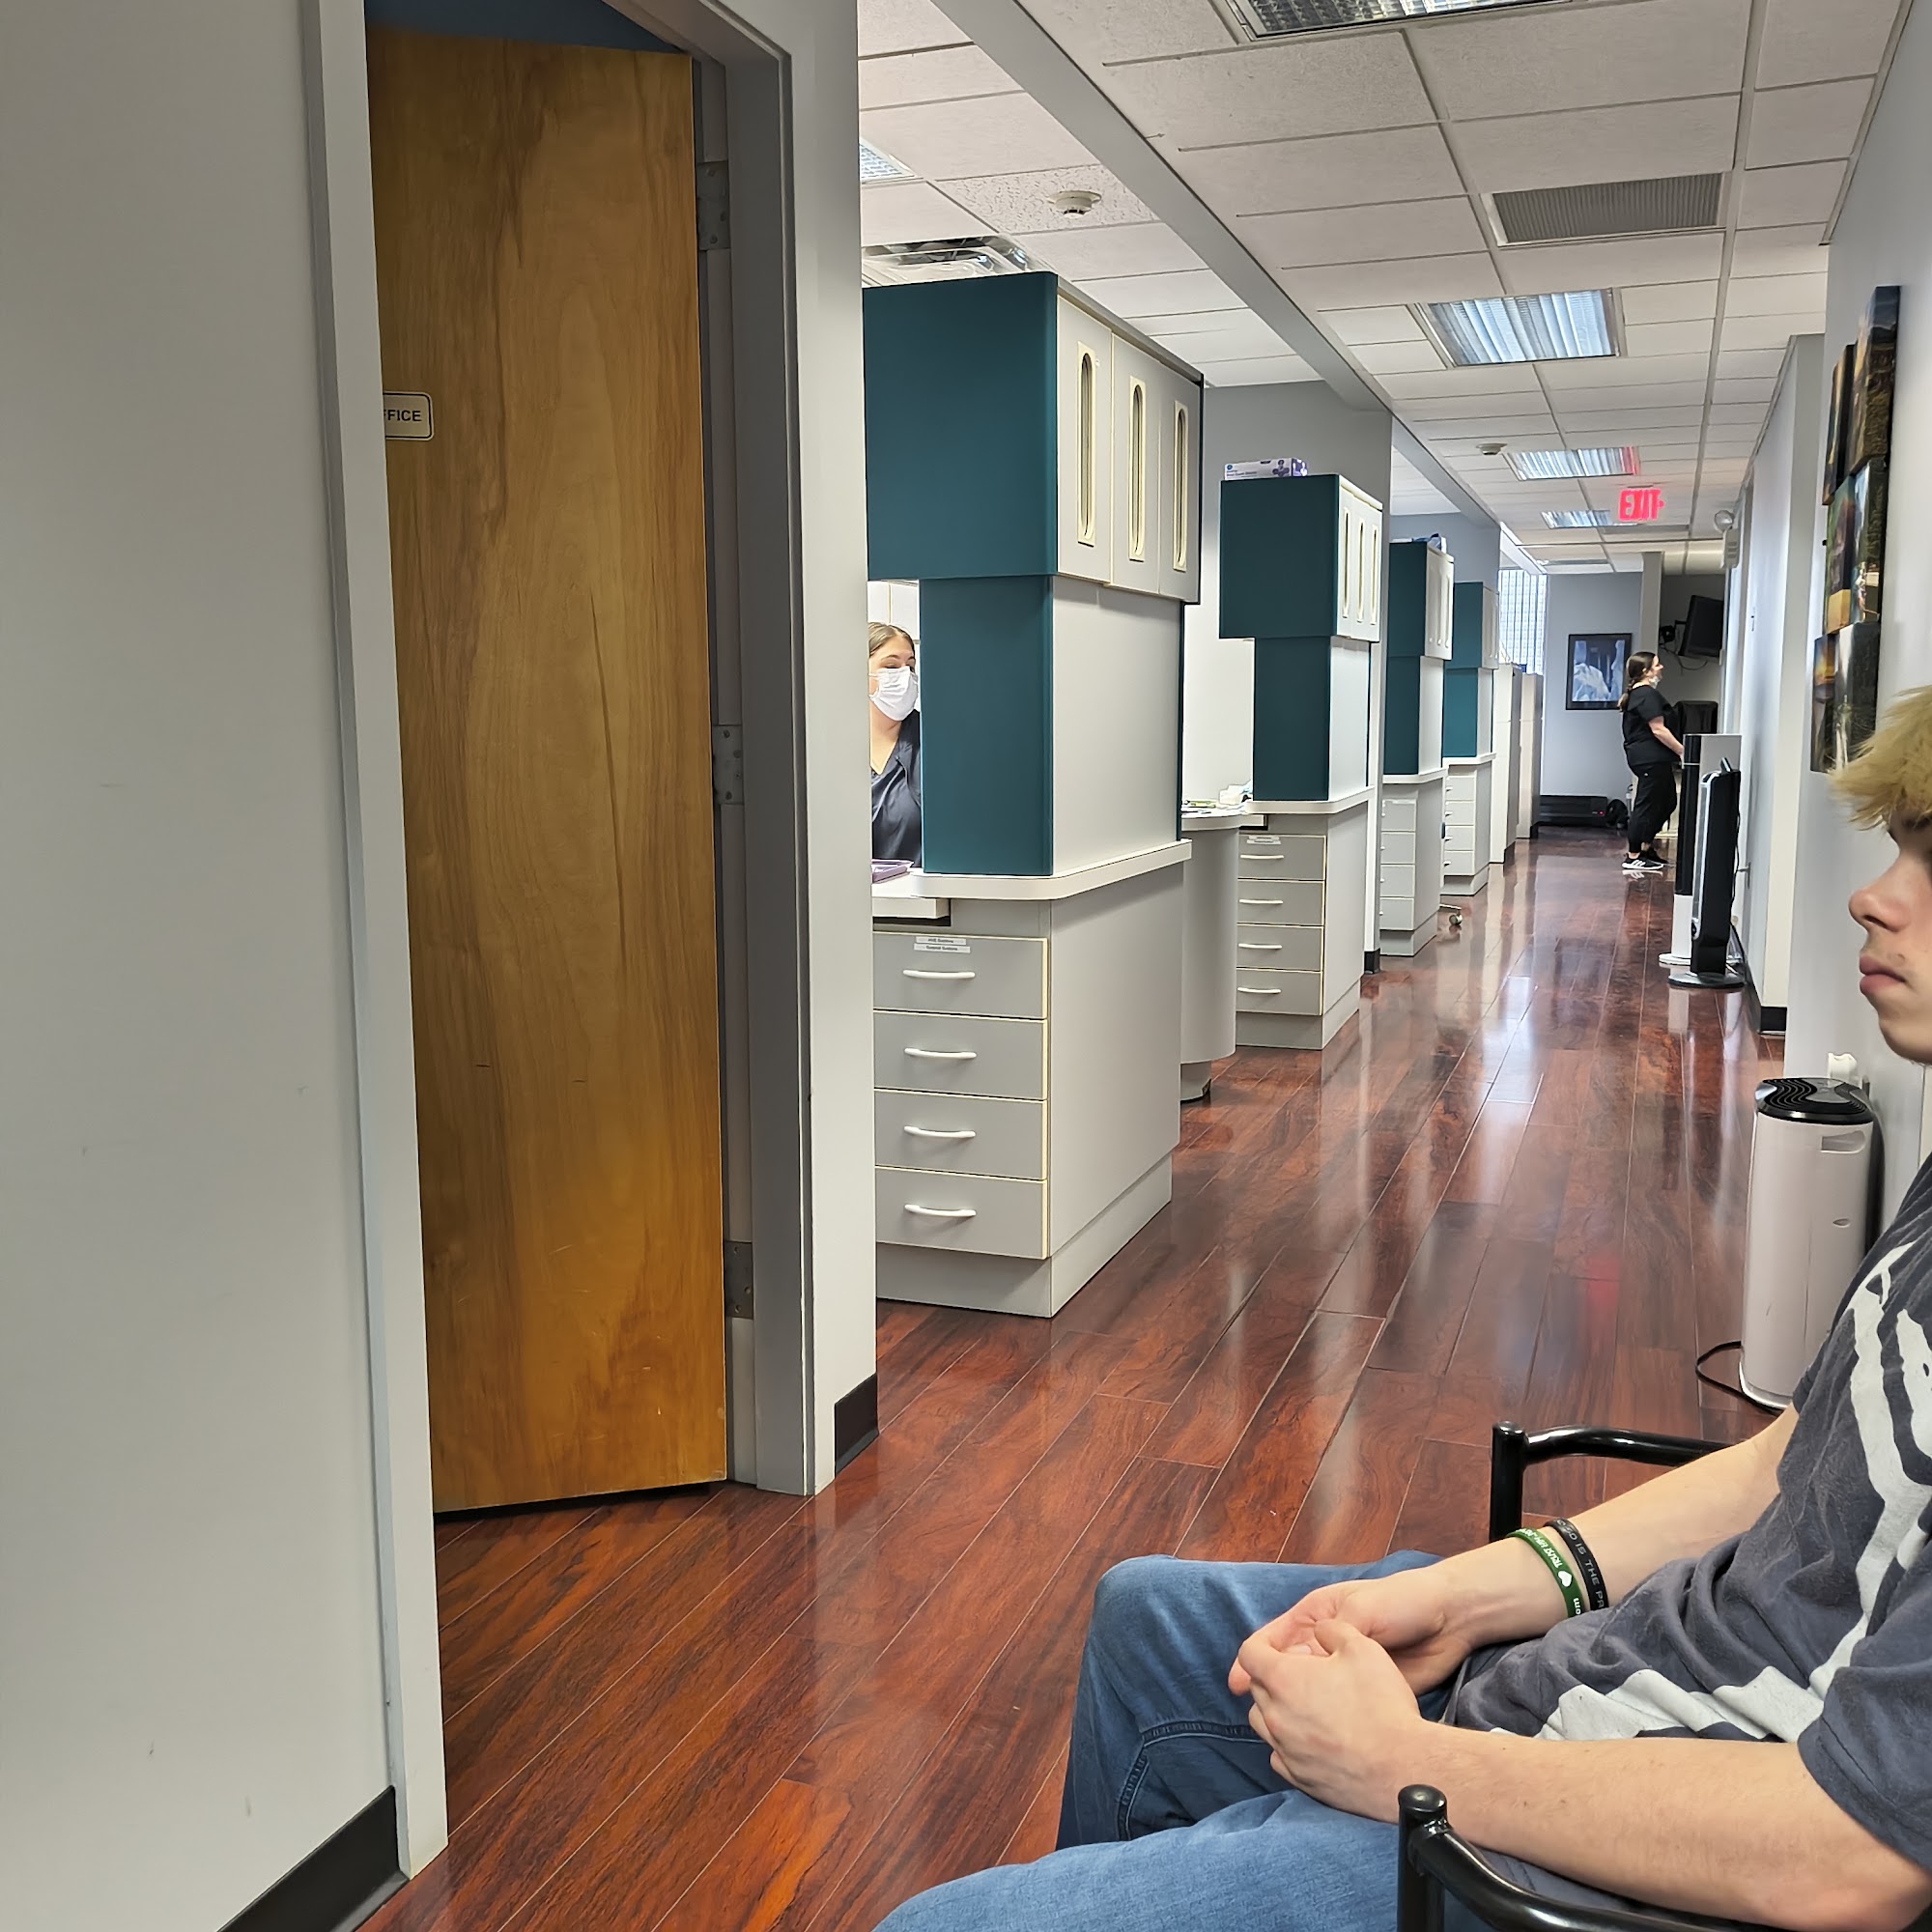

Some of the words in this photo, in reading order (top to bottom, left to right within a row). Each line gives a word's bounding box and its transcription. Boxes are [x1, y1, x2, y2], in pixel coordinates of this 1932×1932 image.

[1619, 489, 1661, 521] EXIT
[1575, 1543, 1586, 1555] IS
[1584, 1559, 1601, 1585] THE
